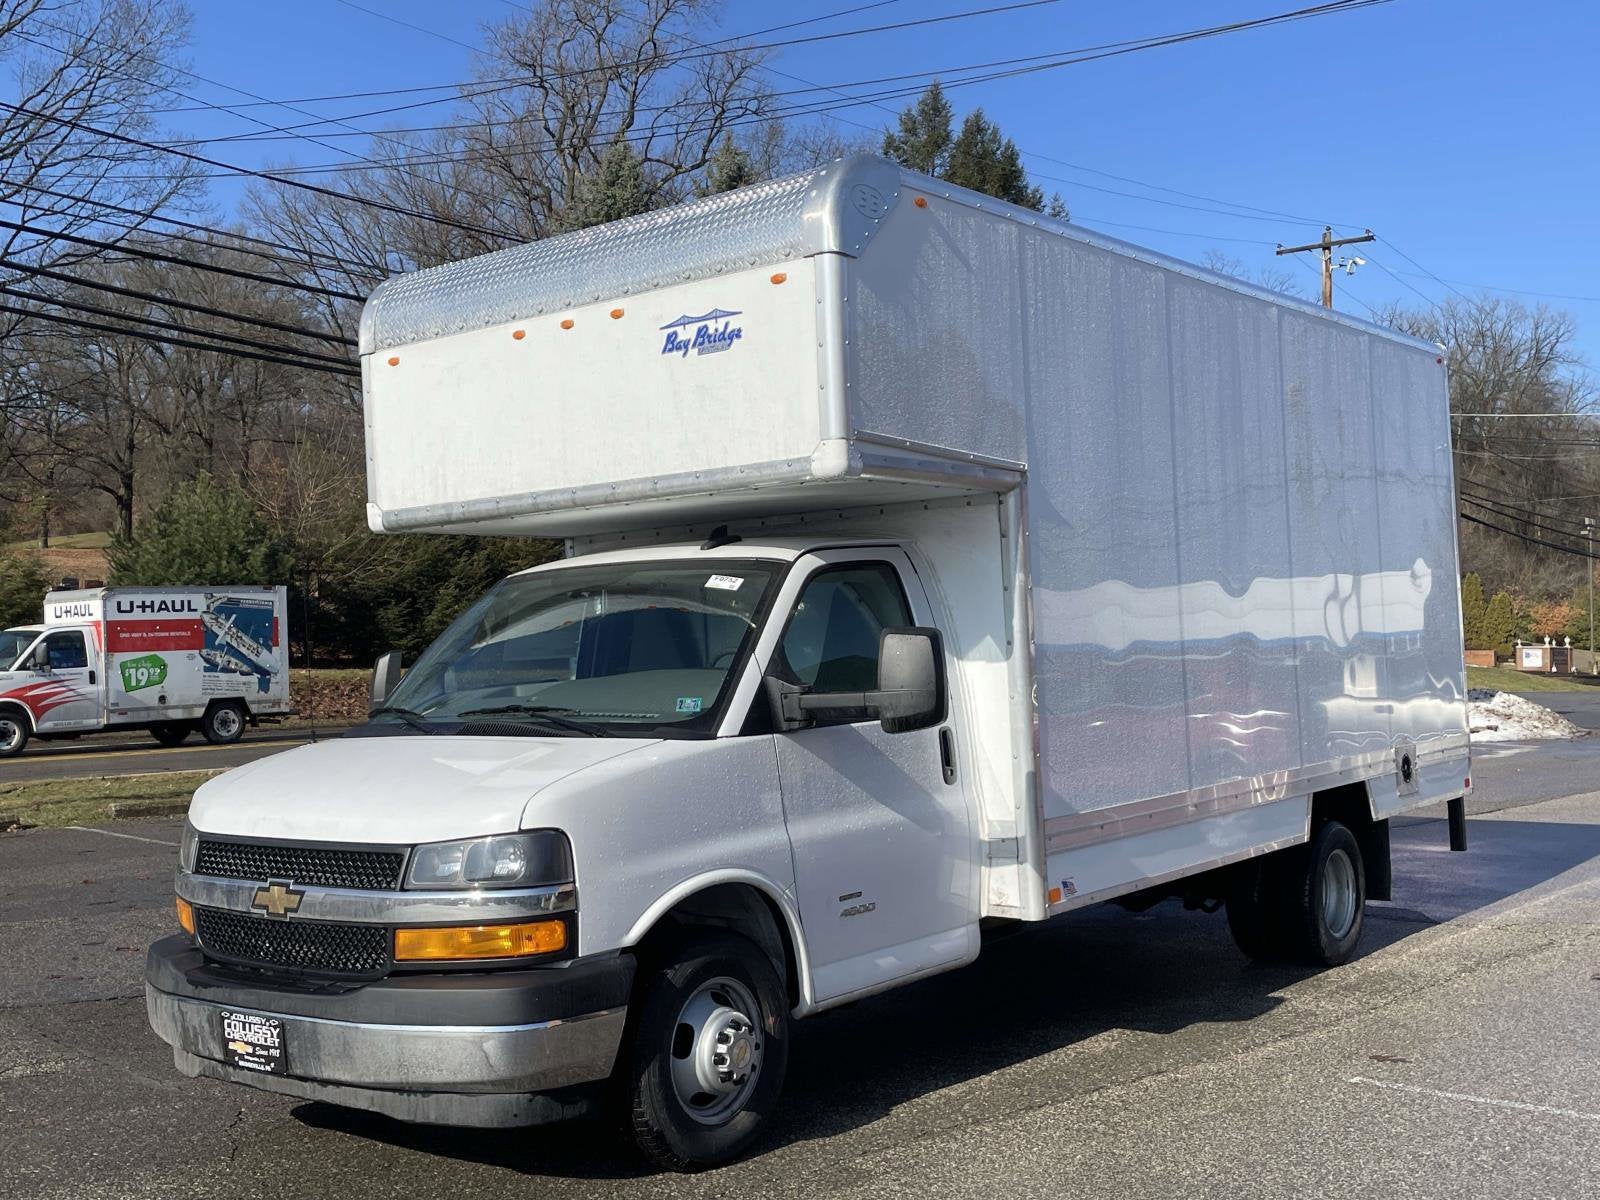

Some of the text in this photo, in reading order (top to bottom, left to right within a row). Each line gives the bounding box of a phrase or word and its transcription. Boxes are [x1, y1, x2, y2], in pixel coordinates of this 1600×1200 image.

[662, 330, 690, 358] Bay
[691, 321, 742, 349] Bridge
[54, 604, 93, 618] U-HAUL
[116, 600, 198, 613] U-HAUL
[224, 1019, 280, 1039] COLUSSY
[224, 1030, 280, 1047] CHEVROLET
